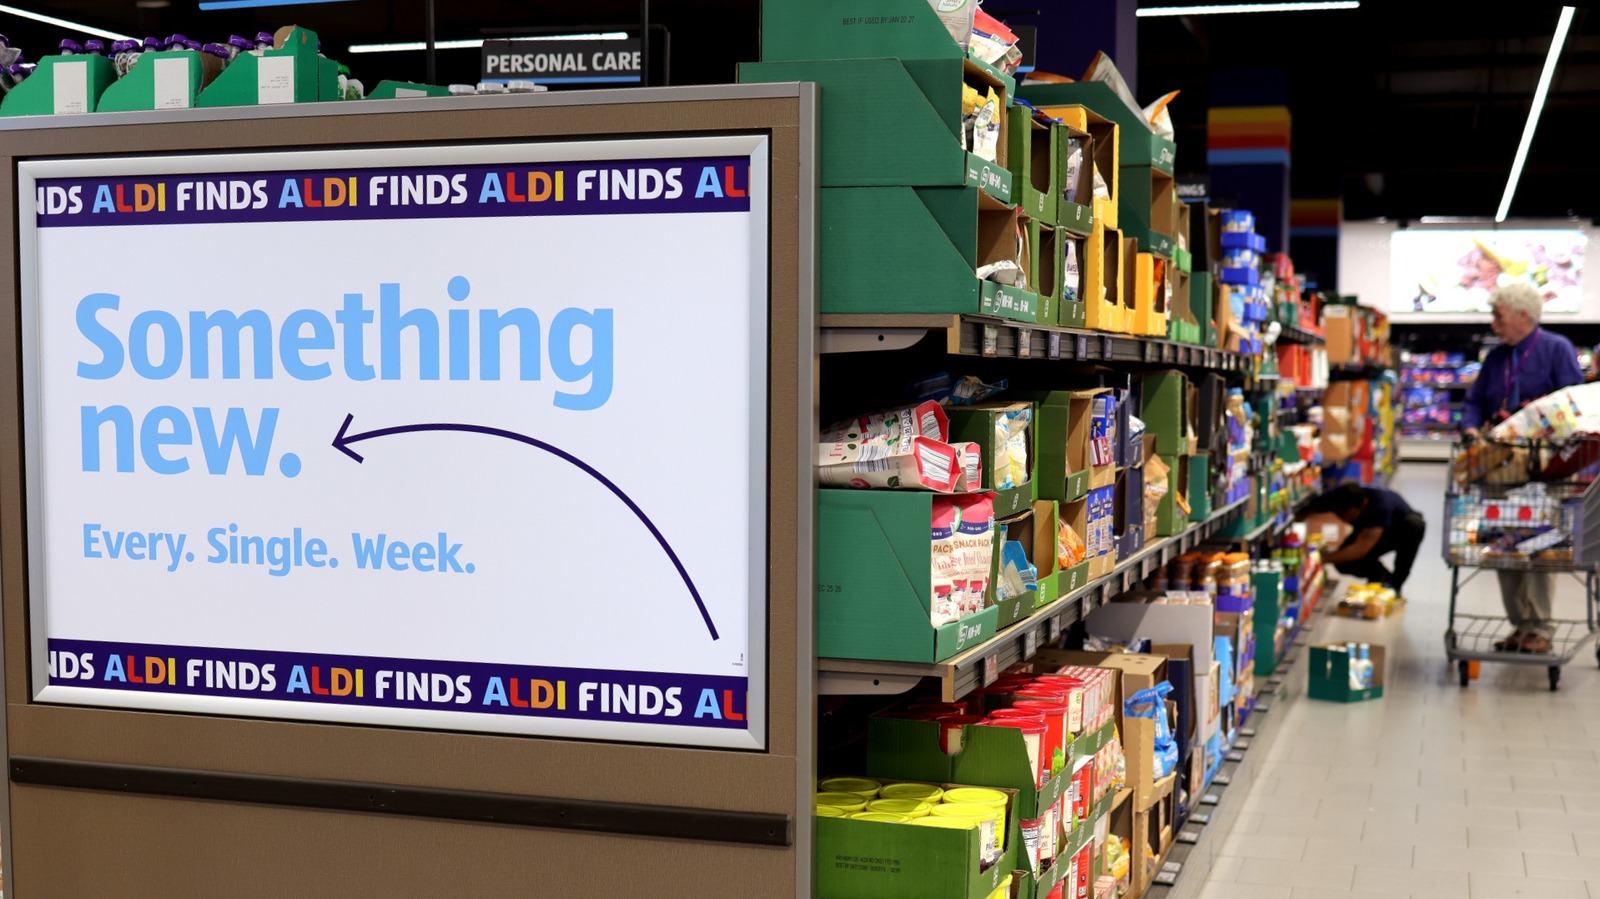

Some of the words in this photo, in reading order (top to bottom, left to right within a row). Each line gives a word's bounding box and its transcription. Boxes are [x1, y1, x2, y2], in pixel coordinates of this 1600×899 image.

[842, 16, 856, 26] BEST
[857, 16, 864, 25] IF
[864, 16, 880, 25] USED
[486, 53, 588, 74] PERSONAL
[591, 51, 641, 71] CARE
[91, 182, 166, 214] ALDI
[176, 177, 269, 212] FINDS
[277, 176, 358, 210] ALDI
[369, 173, 468, 207] FINDS
[478, 170, 564, 205] ALDI
[576, 166, 684, 202] FINDS
[694, 165, 750, 199] AL
[75, 275, 615, 412] Something
[80, 404, 302, 479] new.
[83, 523, 195, 573] Every.
[207, 522, 339, 577] Single.
[351, 531, 477, 576] Week.
[953, 539, 978, 550] SNACK
[103, 653, 176, 687] ALDI
[186, 658, 277, 692] FINDS
[285, 663, 364, 698] ALDI
[375, 668, 473, 706] FINDS
[481, 676, 566, 711] ALDI
[578, 681, 683, 718] FINDS
[693, 687, 748, 721] AL
